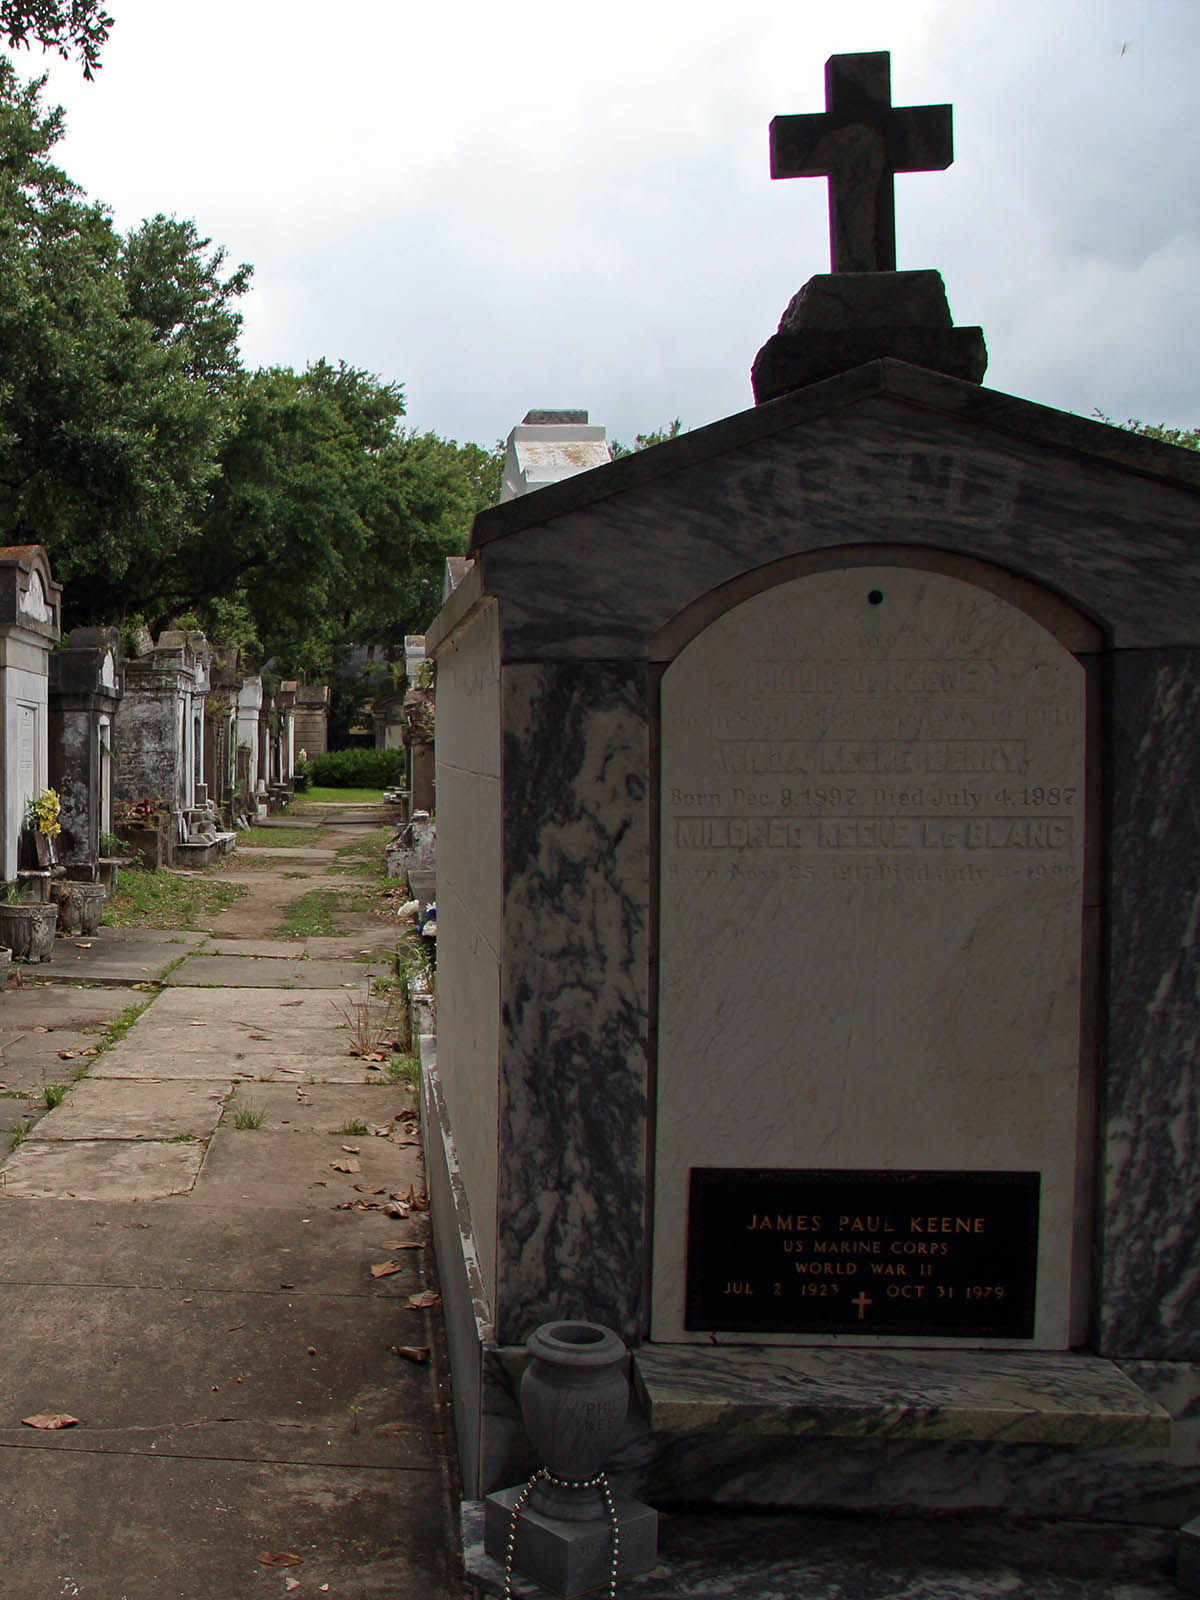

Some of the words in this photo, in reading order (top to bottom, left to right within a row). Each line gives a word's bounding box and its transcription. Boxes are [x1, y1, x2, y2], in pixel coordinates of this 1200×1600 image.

[821, 743, 912, 774] KEENE
[670, 788, 721, 806] Born
[873, 787, 924, 806] Died
[932, 787, 983, 813] July
[676, 819, 803, 849] MILDRED
[818, 818, 911, 848] KEENE
[746, 1214, 822, 1231] JAMES
[839, 1216, 895, 1232] PAUL
[910, 1217, 985, 1234] KEENE
[783, 1240, 804, 1253] US
[815, 1241, 881, 1254] MARINE
[891, 1242, 948, 1255] CORPS
[795, 1262, 857, 1275] WORLD
[871, 1264, 907, 1276] WAR
[723, 1282, 753, 1295] JUL
[772, 1283, 782, 1296] 2
[801, 1283, 839, 1296] 1923
[886, 1285, 925, 1298] OCT
[936, 1286, 953, 1298] 31
[966, 1286, 1005, 1299] 1979
